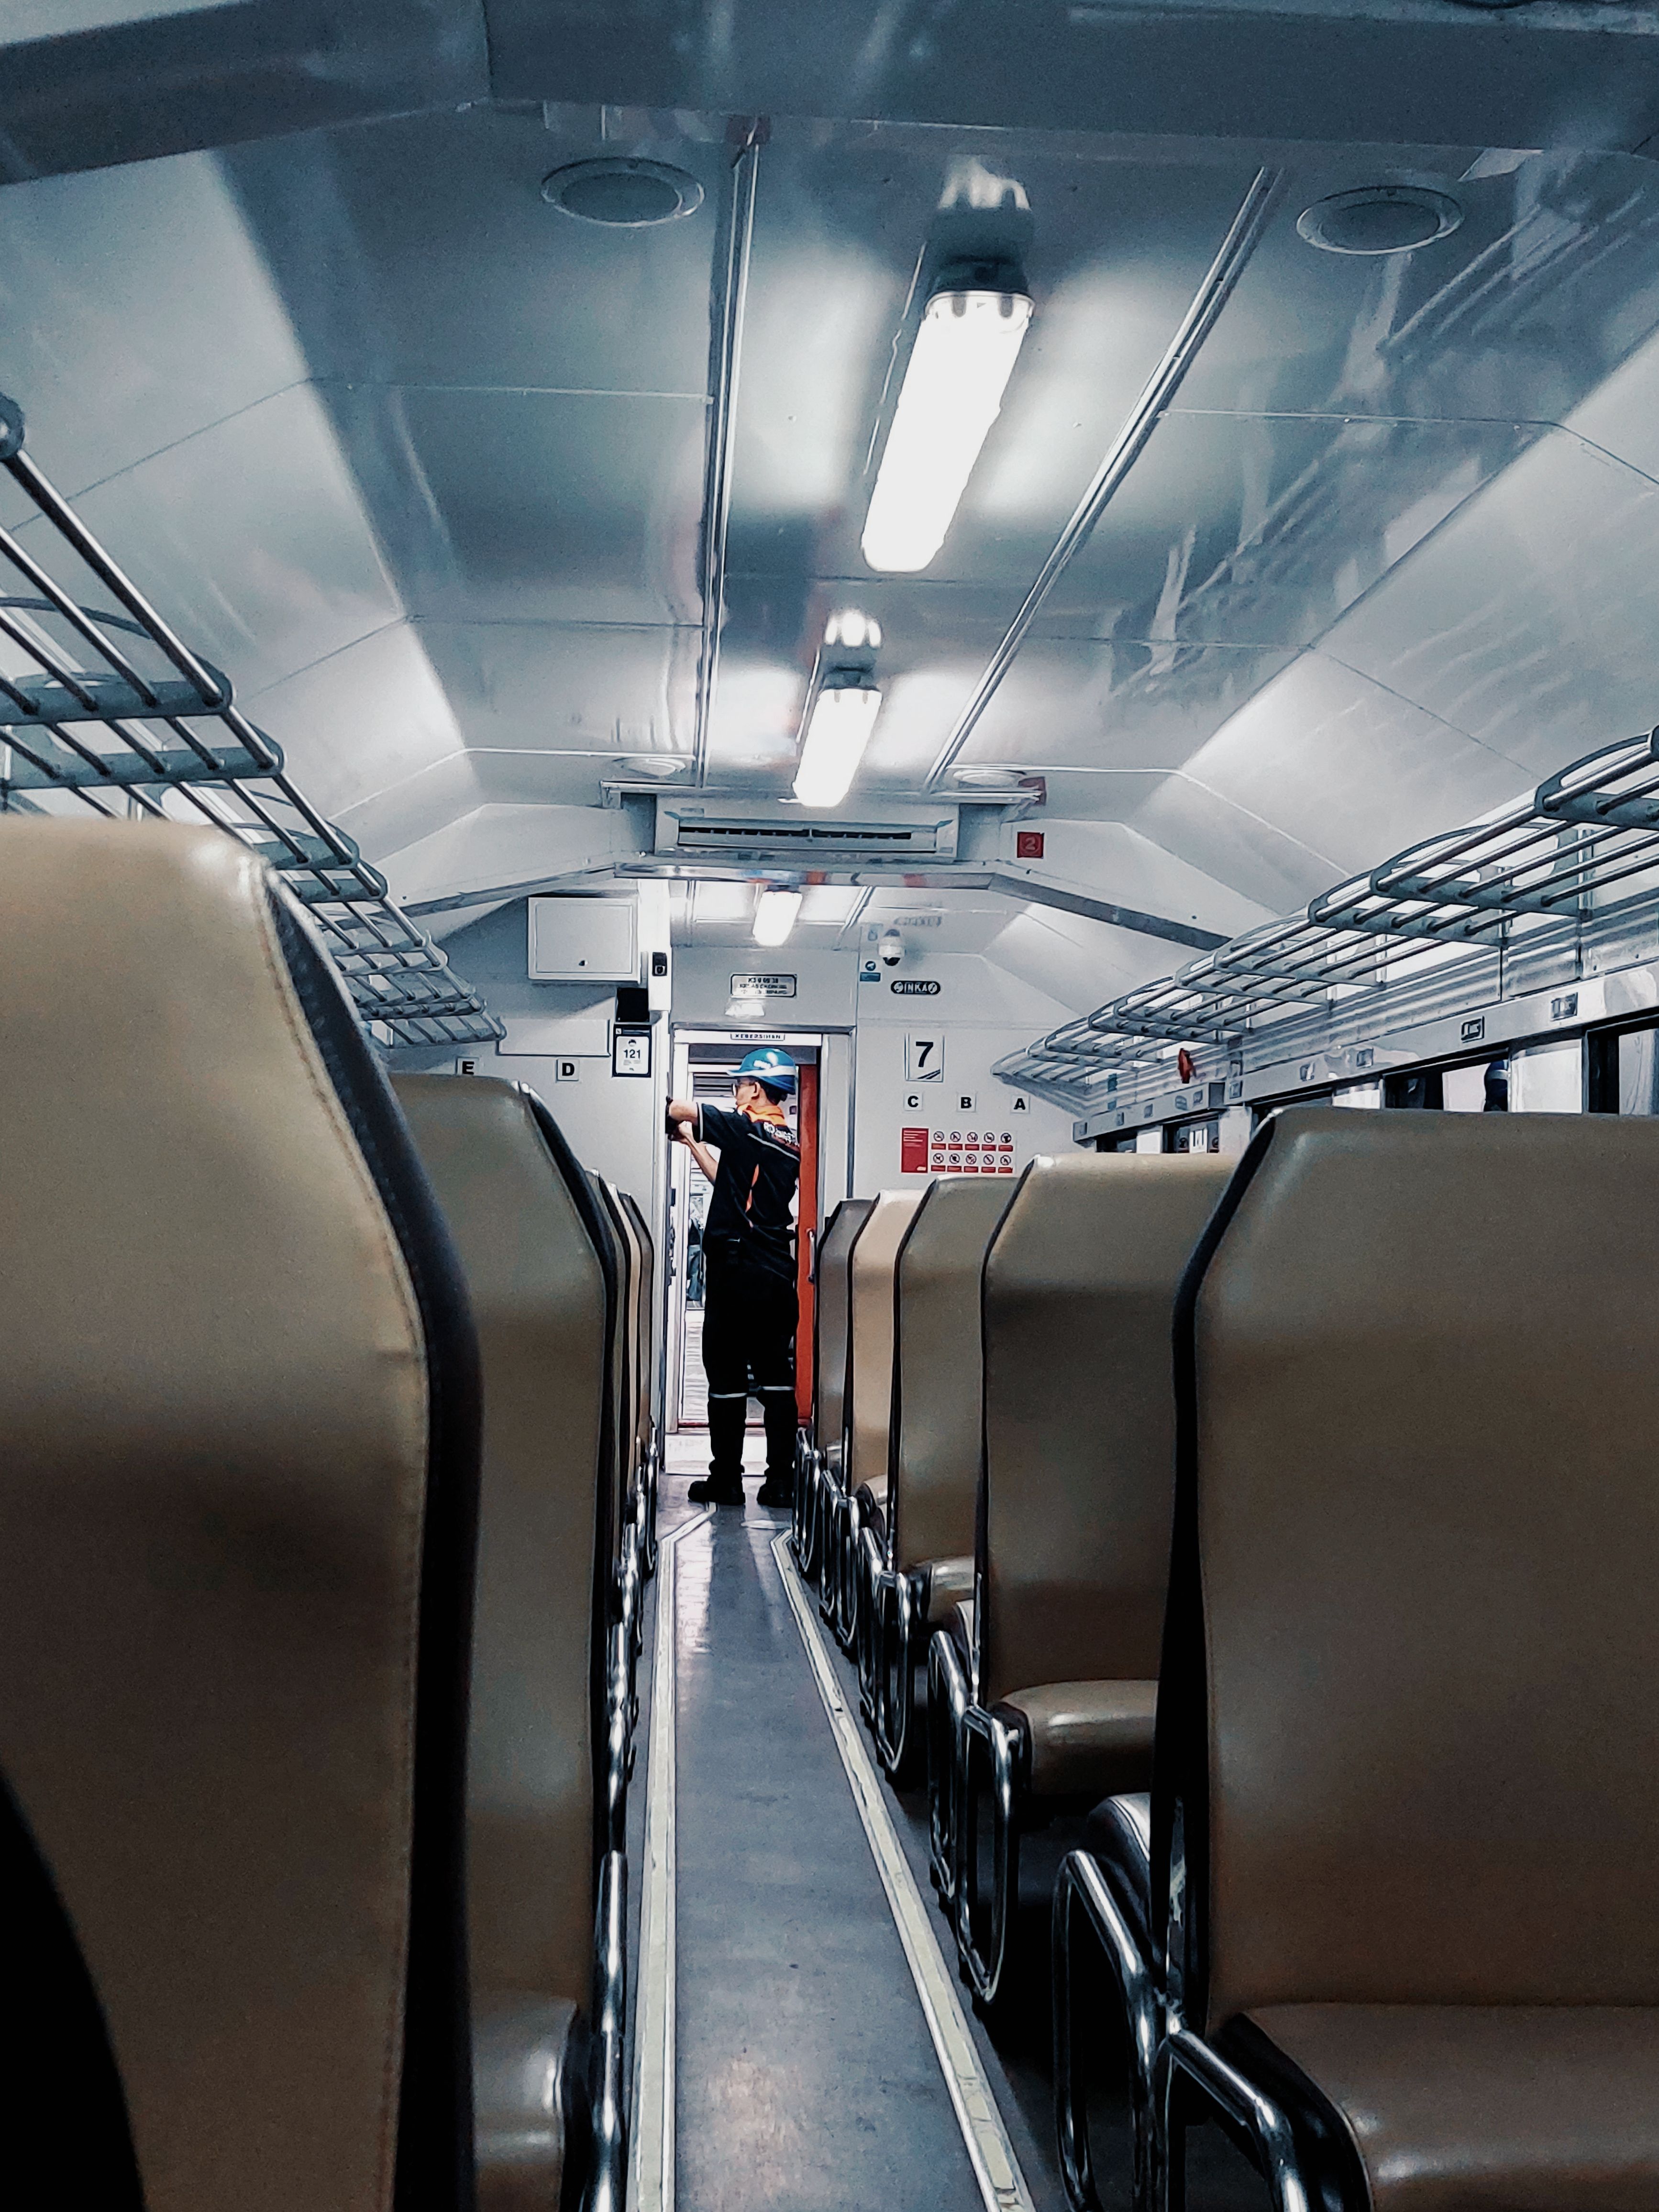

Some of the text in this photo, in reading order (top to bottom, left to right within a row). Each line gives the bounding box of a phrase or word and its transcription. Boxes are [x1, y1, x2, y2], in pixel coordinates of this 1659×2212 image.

[1025, 837, 1036, 851] 2
[624, 1049, 641, 1058] 121
[916, 1041, 934, 1067] 7
[462, 1061, 475, 1075] E
[562, 1062, 575, 1076] D
[908, 1095, 918, 1107] C
[961, 1096, 972, 1109] B
[1014, 1098, 1026, 1110] A
